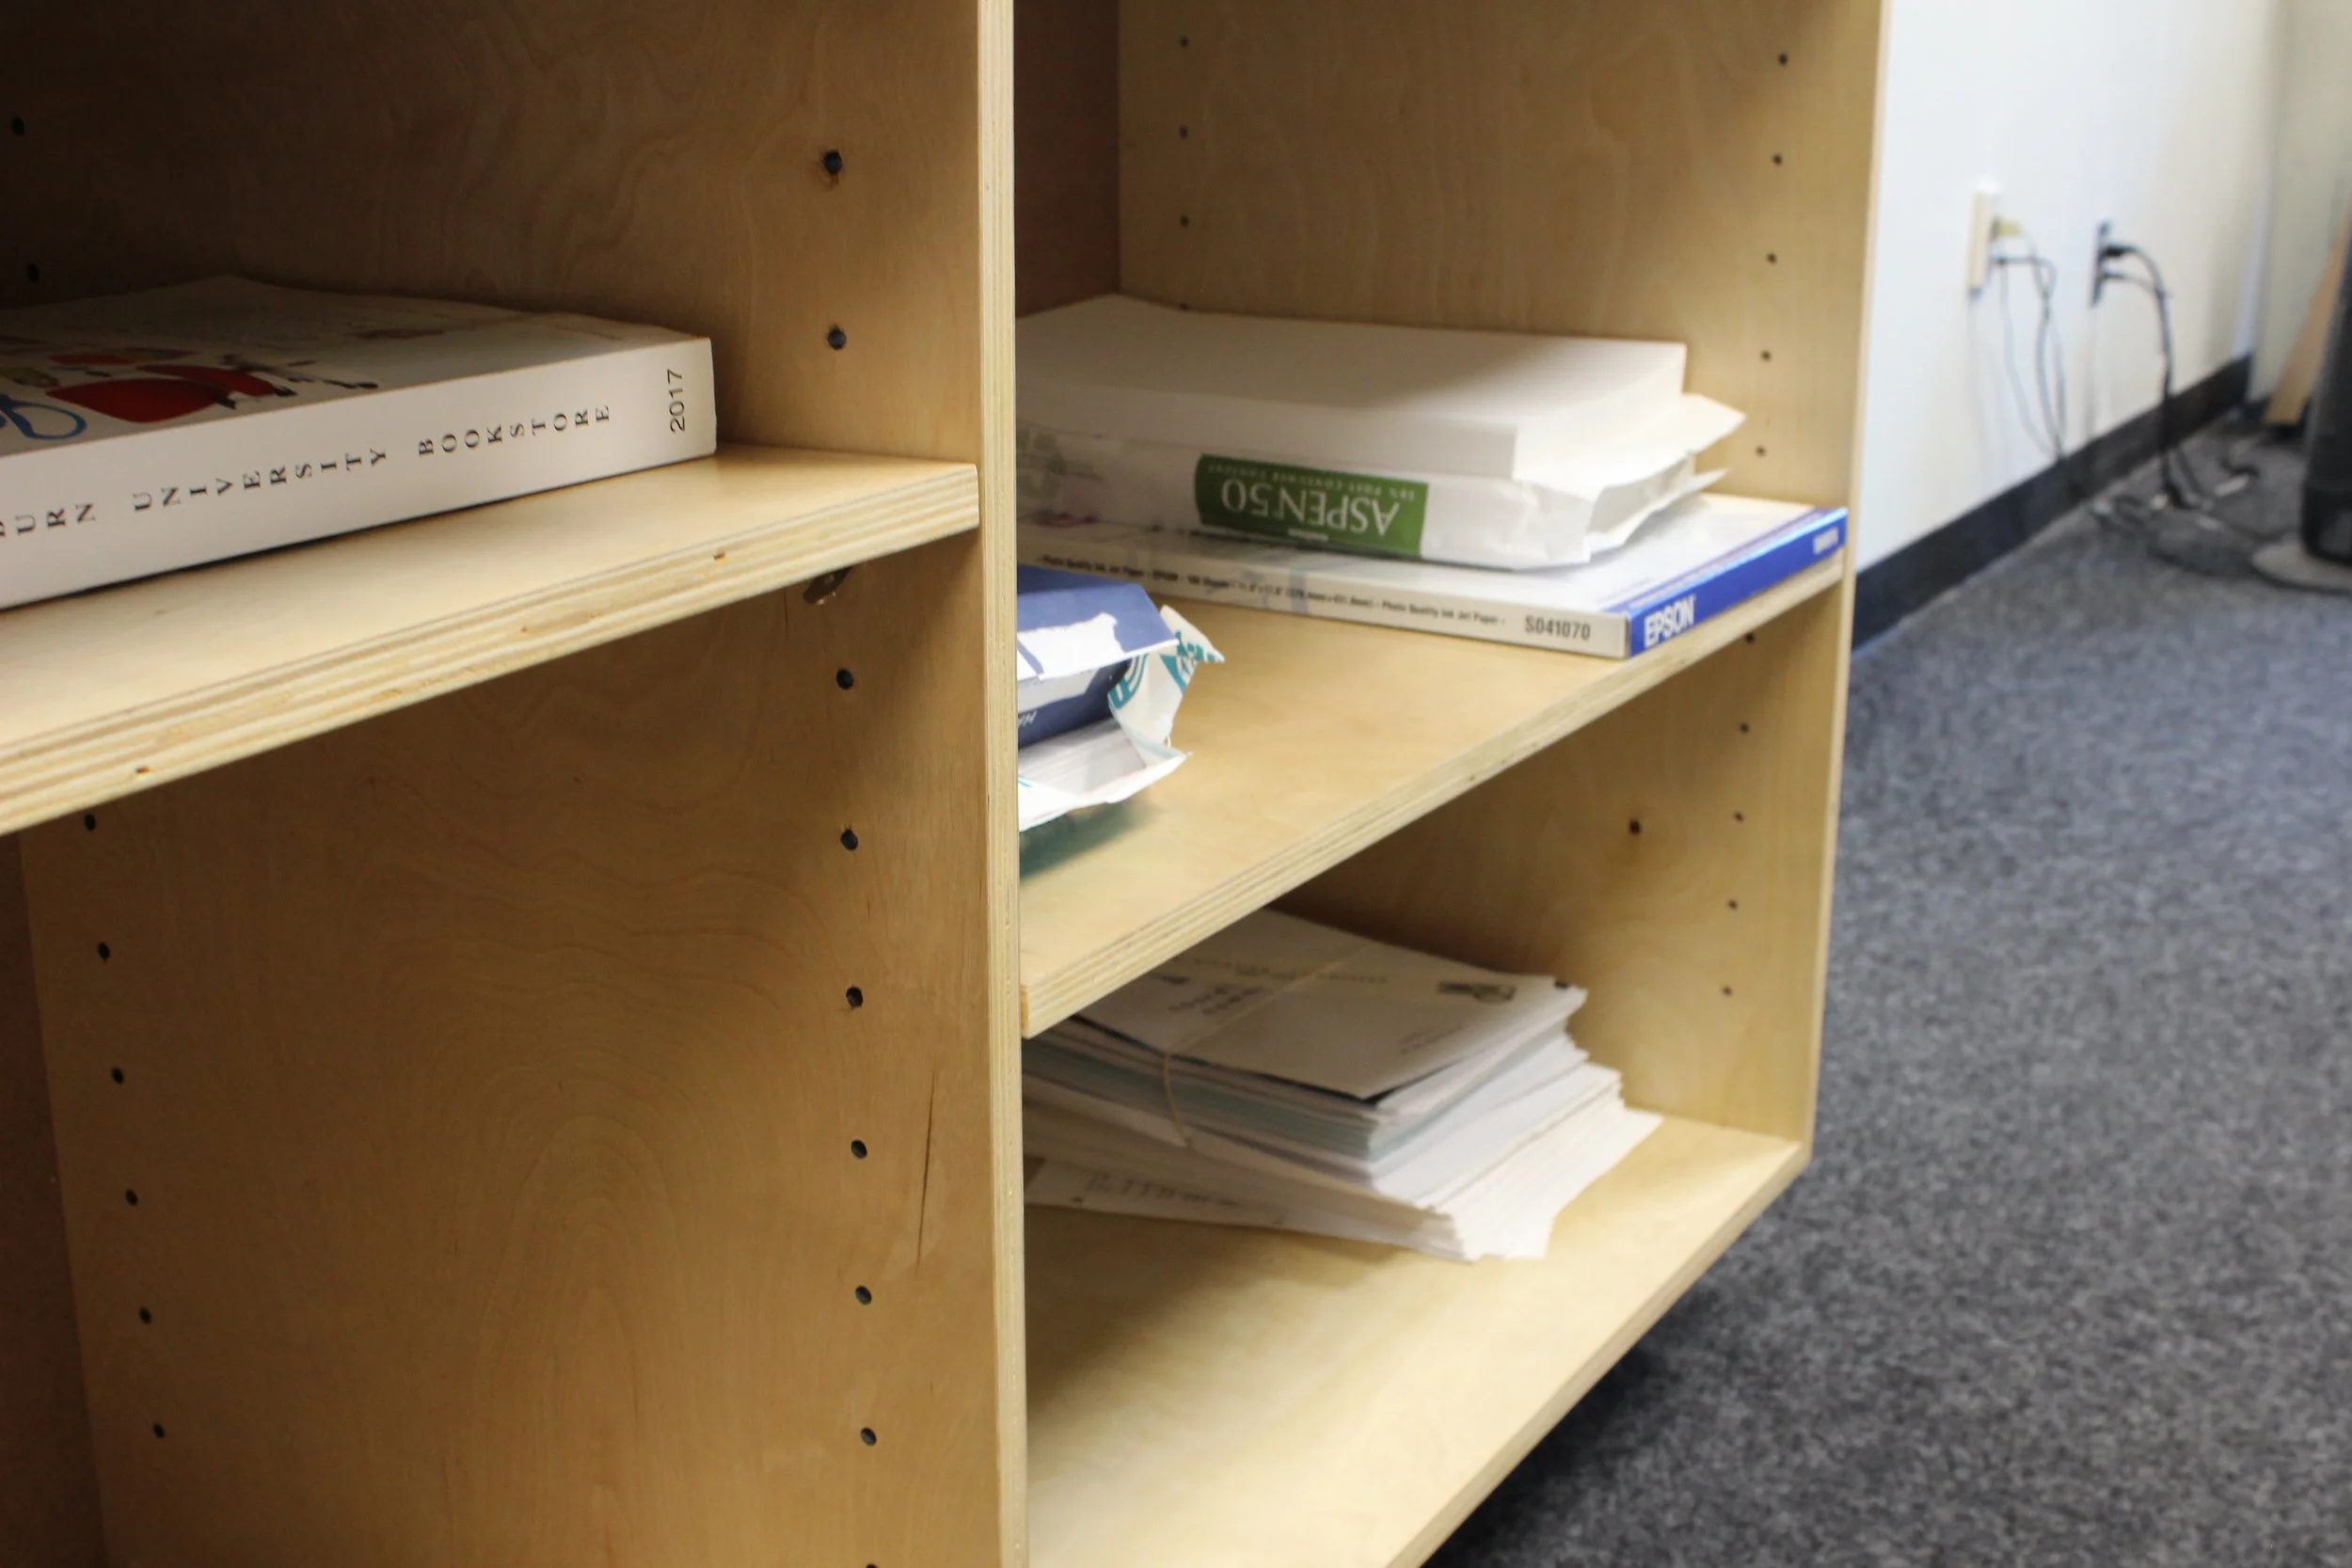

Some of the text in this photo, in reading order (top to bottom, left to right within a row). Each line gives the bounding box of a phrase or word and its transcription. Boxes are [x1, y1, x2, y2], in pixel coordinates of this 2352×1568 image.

[666, 368, 686, 434] 2017
[132, 447, 388, 513] UNIVERSITY
[418, 404, 611, 458] BOOKSTORE
[1523, 614, 1592, 641] S041070
[1644, 594, 1695, 649] EPSON
